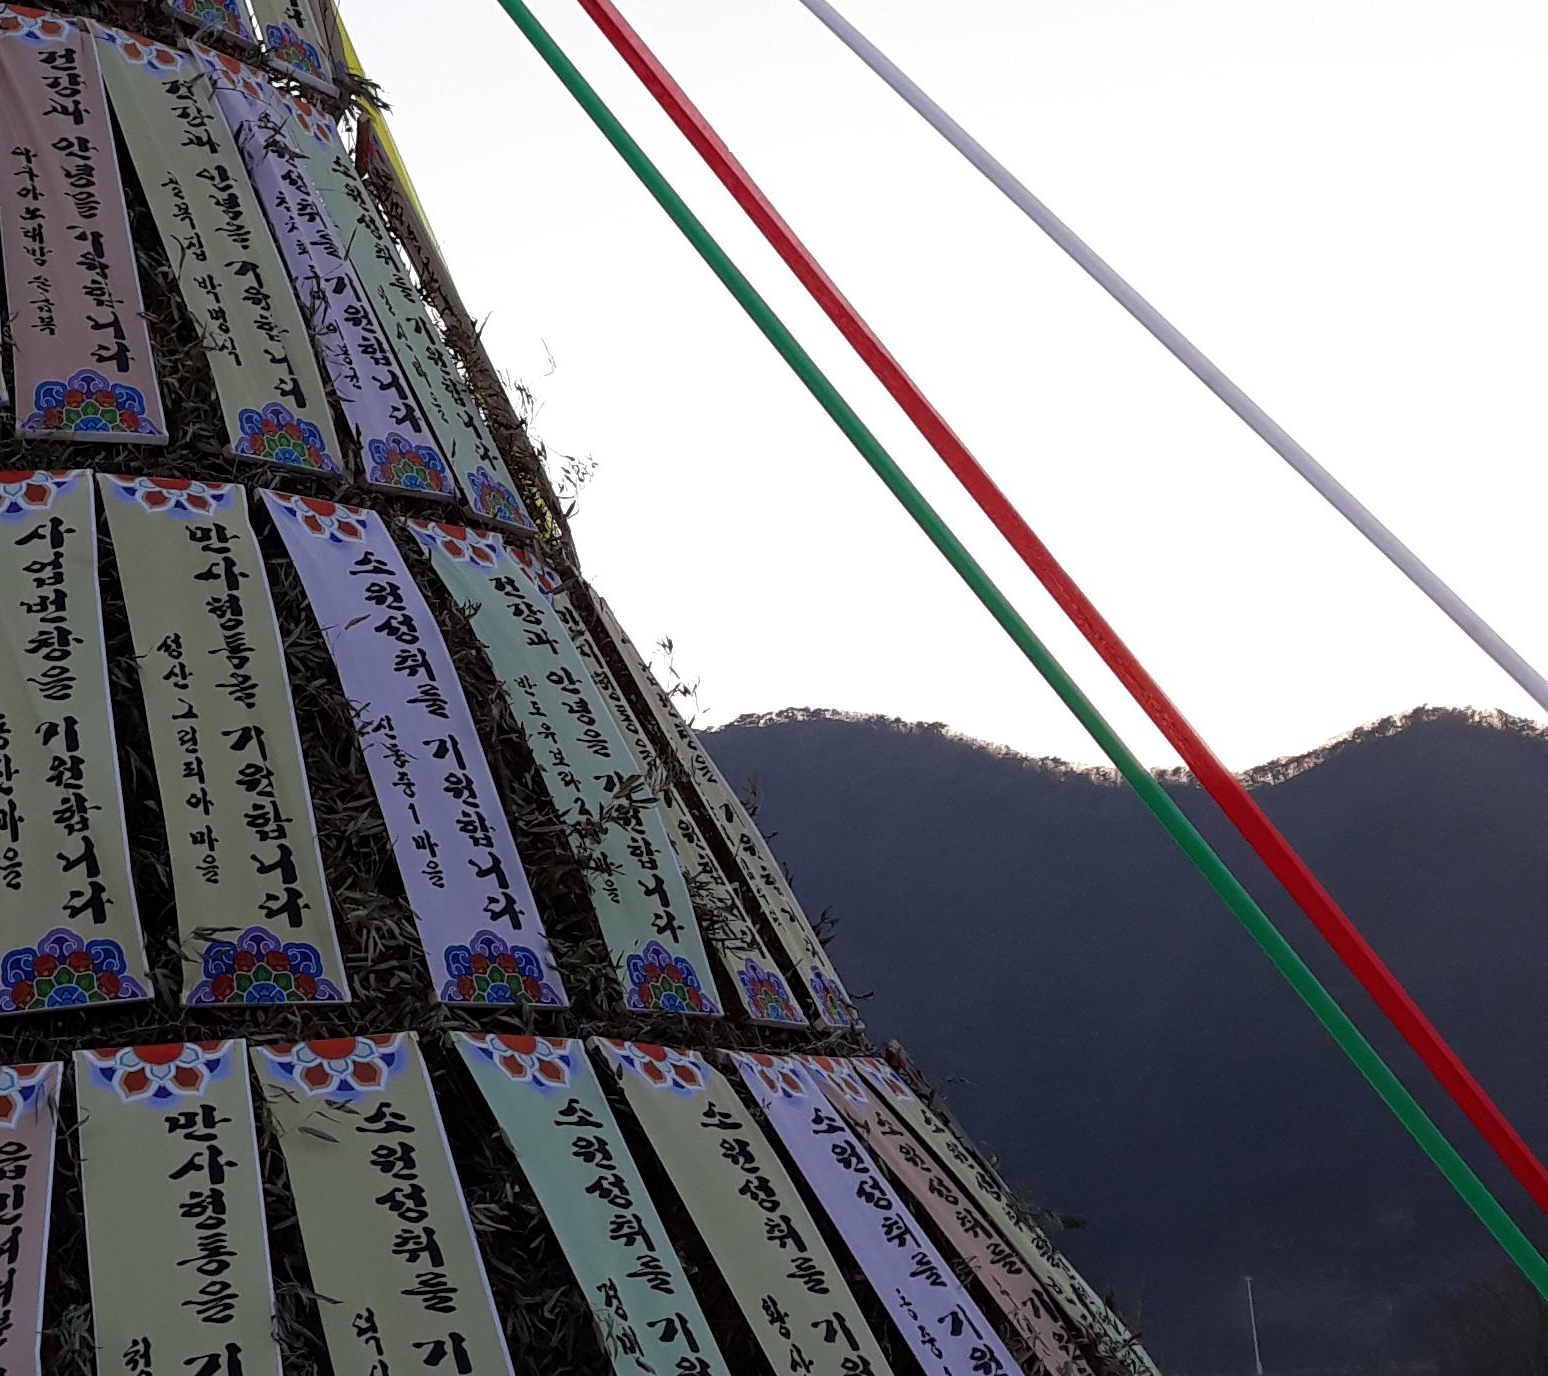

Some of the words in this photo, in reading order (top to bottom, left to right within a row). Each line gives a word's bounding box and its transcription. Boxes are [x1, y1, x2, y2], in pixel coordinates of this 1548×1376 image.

[38, 47, 91, 125] 건강과
[51, 135, 100, 219] 안녕을
[66, 225, 135, 373] 기원합니다
[163, 77, 222, 155] 건강과
[225, 259, 306, 410] 기원합니다
[324, 274, 424, 434] 기원합니다
[412, 316, 496, 471] 기원합니다
[15, 516, 84, 702] 사업번창을
[184, 523, 259, 710] 만사형통을
[489, 575, 561, 655] 건강과
[546, 666, 612, 758] 안녕을
[34, 715, 113, 926] 기원합니다
[221, 724, 312, 929] 기원합니다
[349, 550, 451, 720] 소원성취를
[423, 734, 525, 931] 기원합니다
[165, 1103, 239, 1325] 만사형통을
[355, 1101, 460, 1314] 소원성취를
[553, 1097, 675, 1296] 소원성취를
[699, 1101, 830, 1296] 소원성취를
[810, 1107, 948, 1288] 소원성취를
[874, 1110, 1023, 1277] 소원성취를
